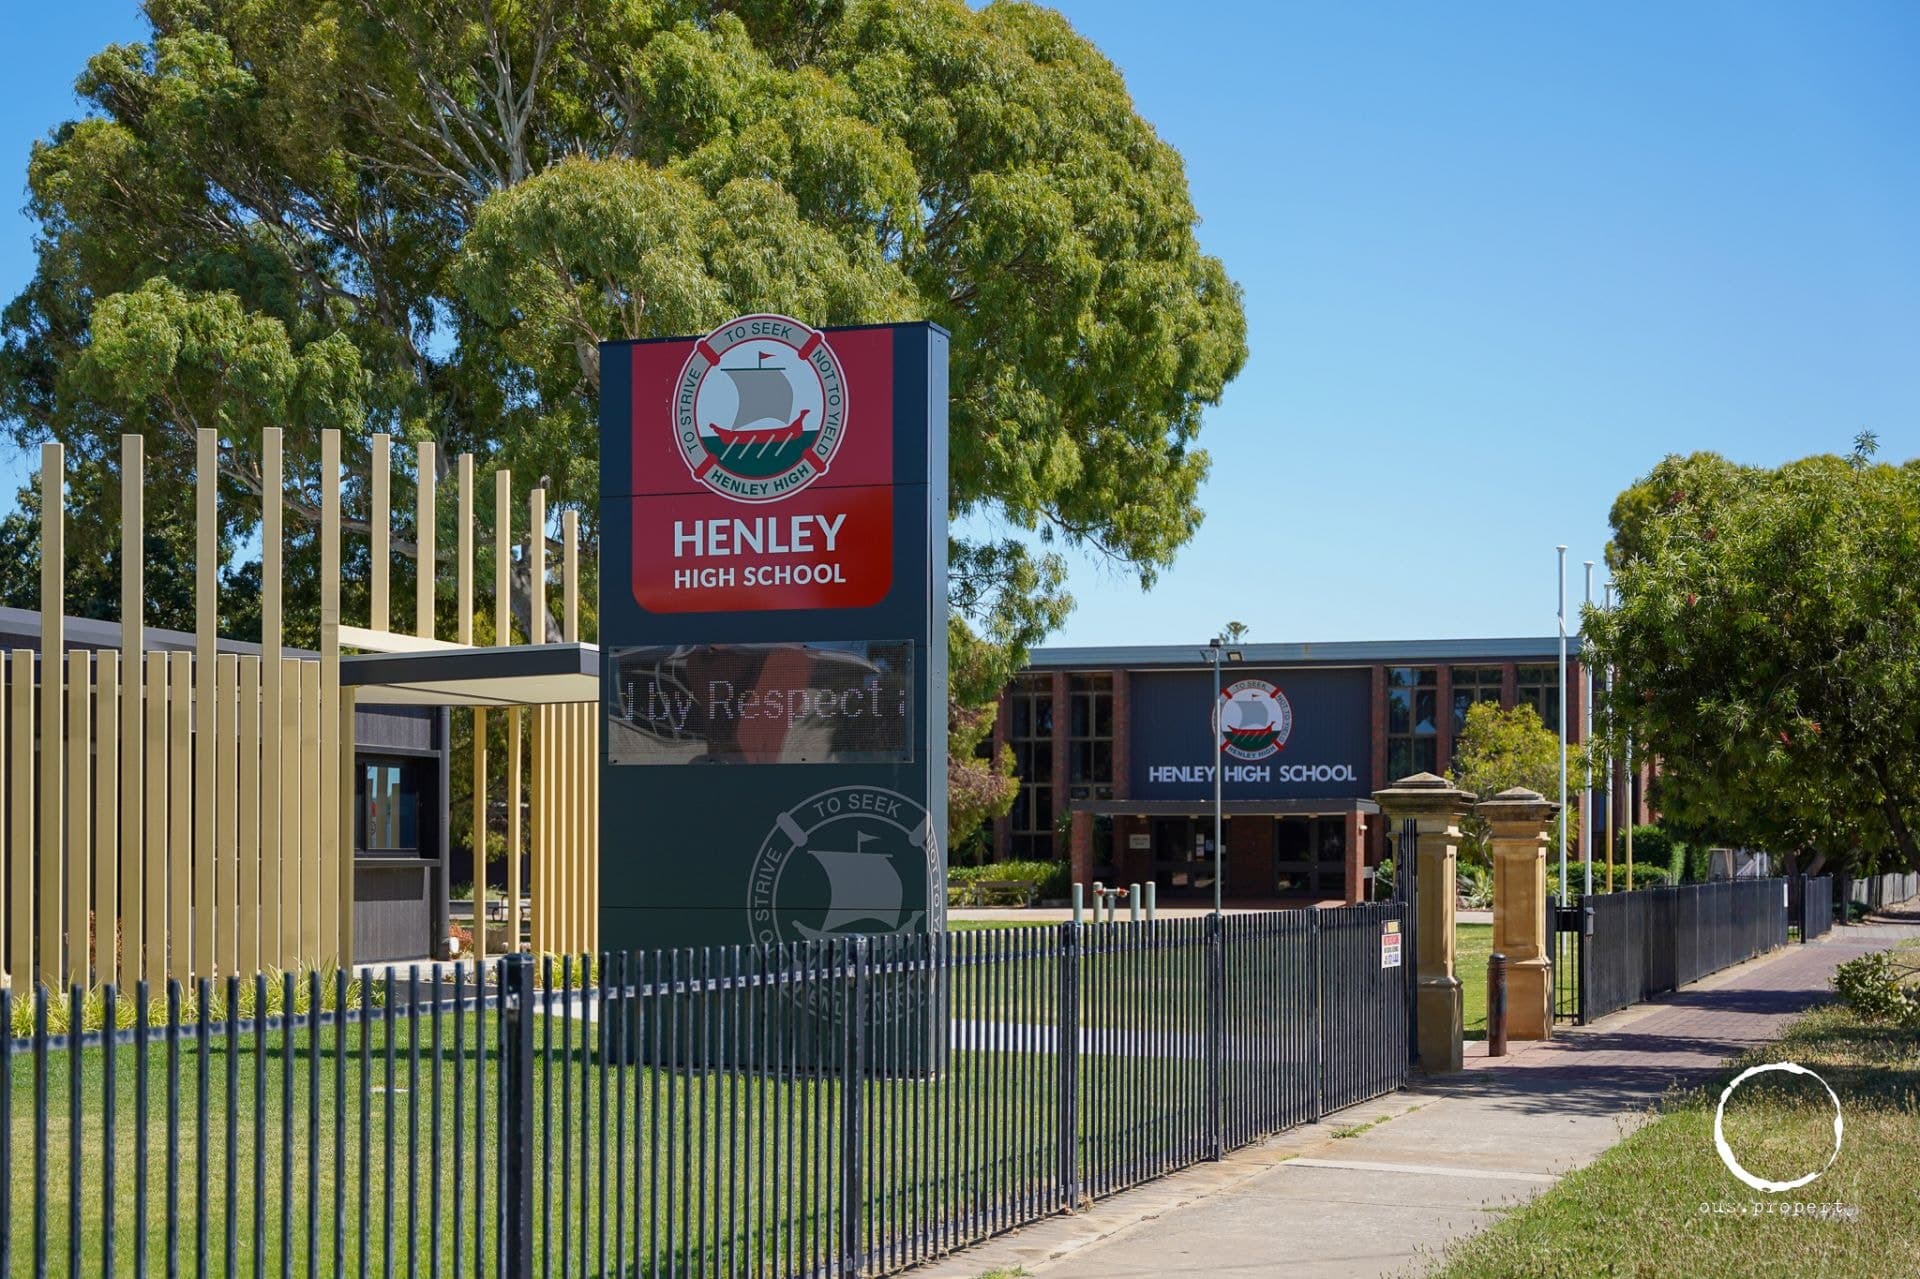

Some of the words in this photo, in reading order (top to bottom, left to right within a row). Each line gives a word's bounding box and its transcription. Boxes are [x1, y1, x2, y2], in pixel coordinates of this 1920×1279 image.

[724, 326, 746, 343] TO
[751, 322, 793, 340] SEEK
[812, 349, 837, 380] NOT
[679, 367, 702, 426] STRIVE
[828, 383, 841, 406] TO
[683, 431, 698, 455] TO
[816, 412, 841, 456] YIELD
[711, 469, 769, 496] HENLEY
[773, 464, 810, 492] HIGH
[673, 513, 848, 558] HENLEY
[673, 567, 736, 590] HIGH
[742, 563, 847, 588] SCHOOL
[1234, 682, 1246, 690] TO
[1247, 681, 1267, 690] SEEK
[648, 681, 695, 731] by
[709, 680, 884, 729] Respect
[1227, 746, 1257, 759] HENLEY
[1258, 745, 1277, 758] HIGH
[1149, 766, 1216, 783] HENLEY
[1224, 766, 1270, 783] HIGH
[1279, 764, 1357, 783] SCHOOL
[813, 796, 841, 817] TO
[848, 793, 902, 818] SEEK
[754, 847, 783, 922] STRIVE
[933, 882, 940, 908] TO
